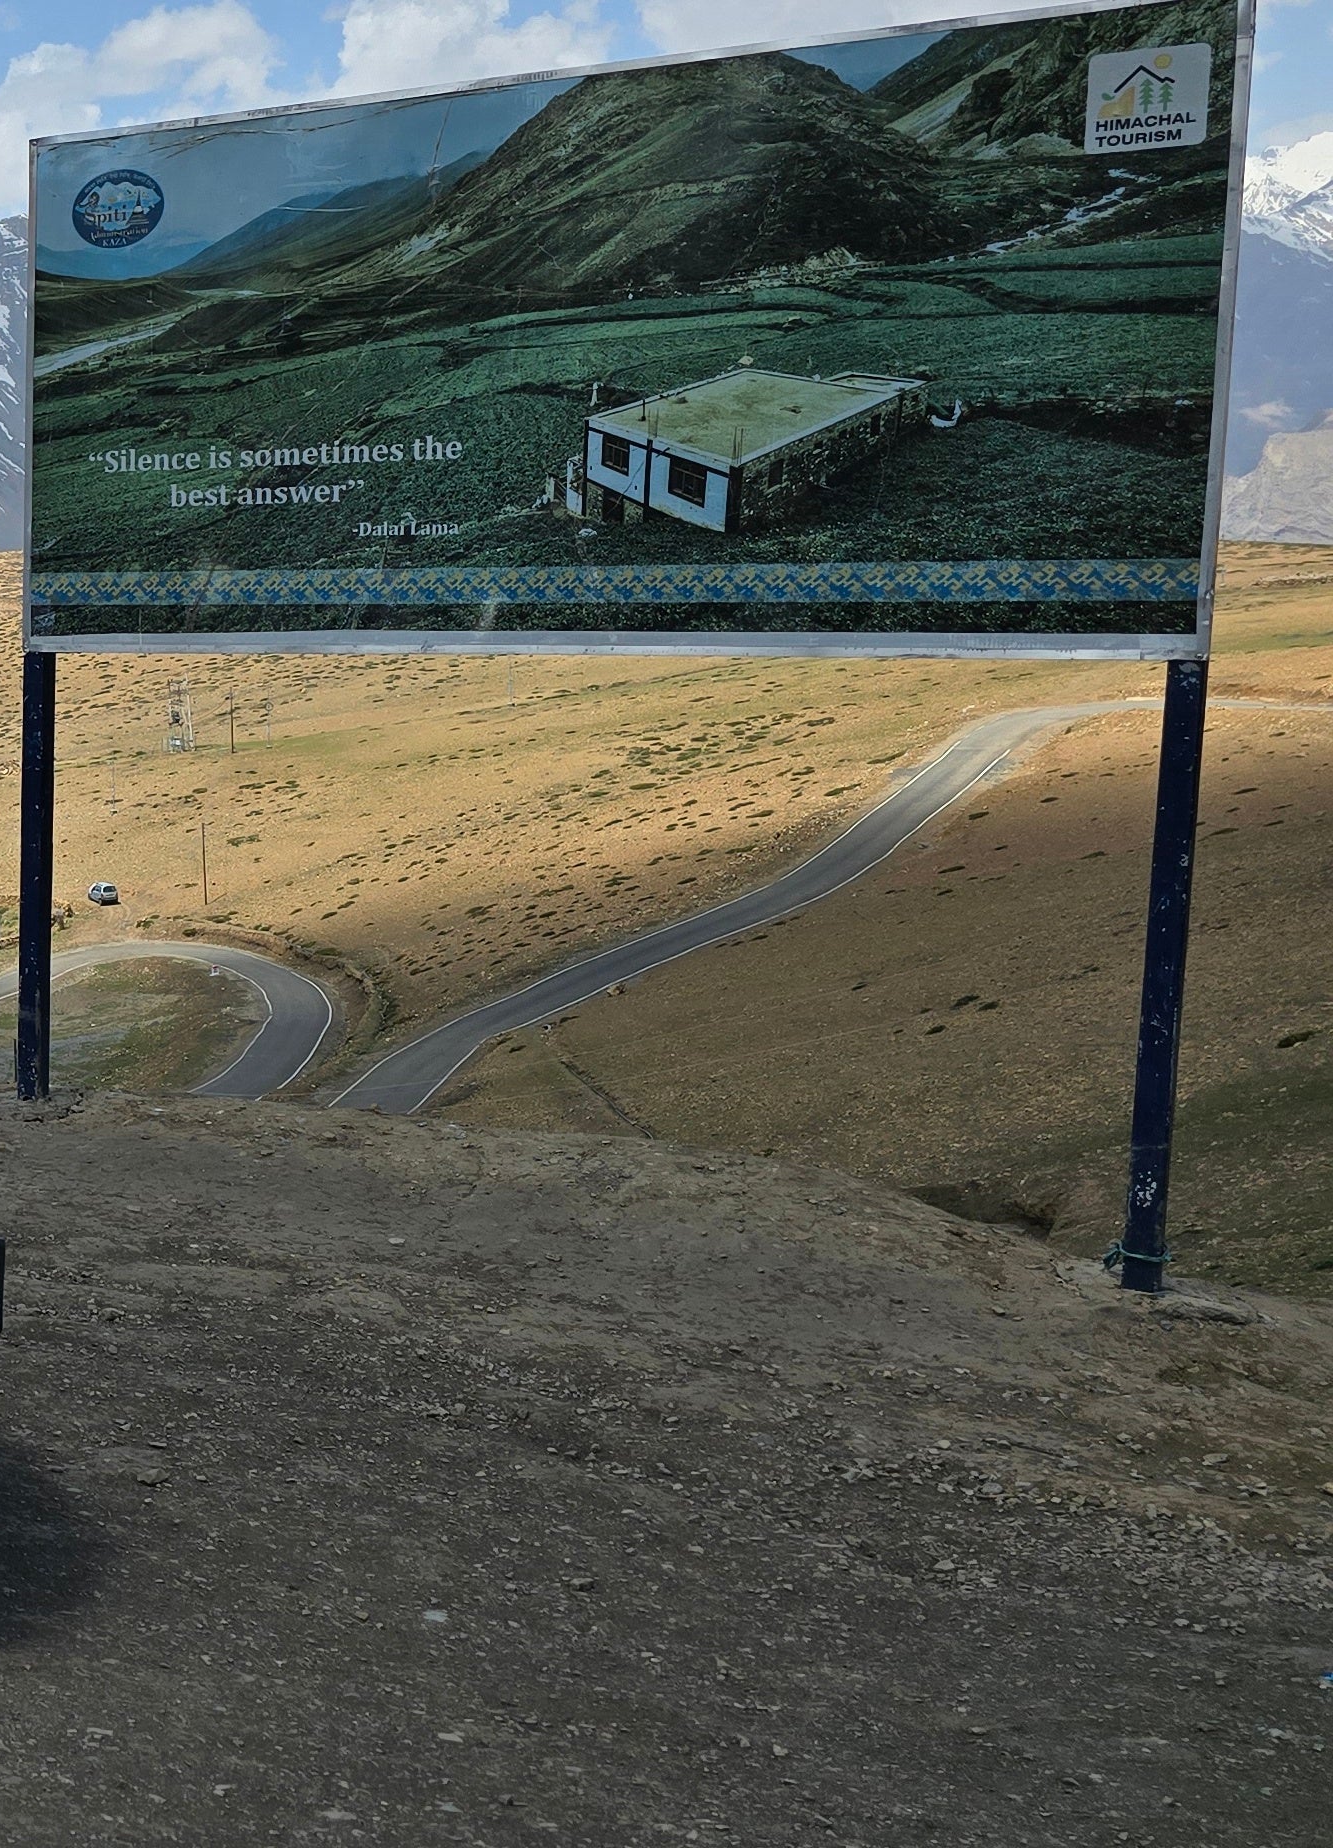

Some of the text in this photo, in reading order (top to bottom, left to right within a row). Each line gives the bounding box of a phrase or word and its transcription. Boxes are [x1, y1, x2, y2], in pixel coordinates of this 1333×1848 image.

[1095, 112, 1196, 132] HIMACHAL
[1095, 129, 1182, 148] TOURISM
[102, 238, 127, 247] KAZA
[209, 445, 232, 470] is
[240, 440, 404, 467] sometimes
[412, 434, 463, 461] the
[170, 482, 231, 508] best
[411, 520, 460, 536] Lama
